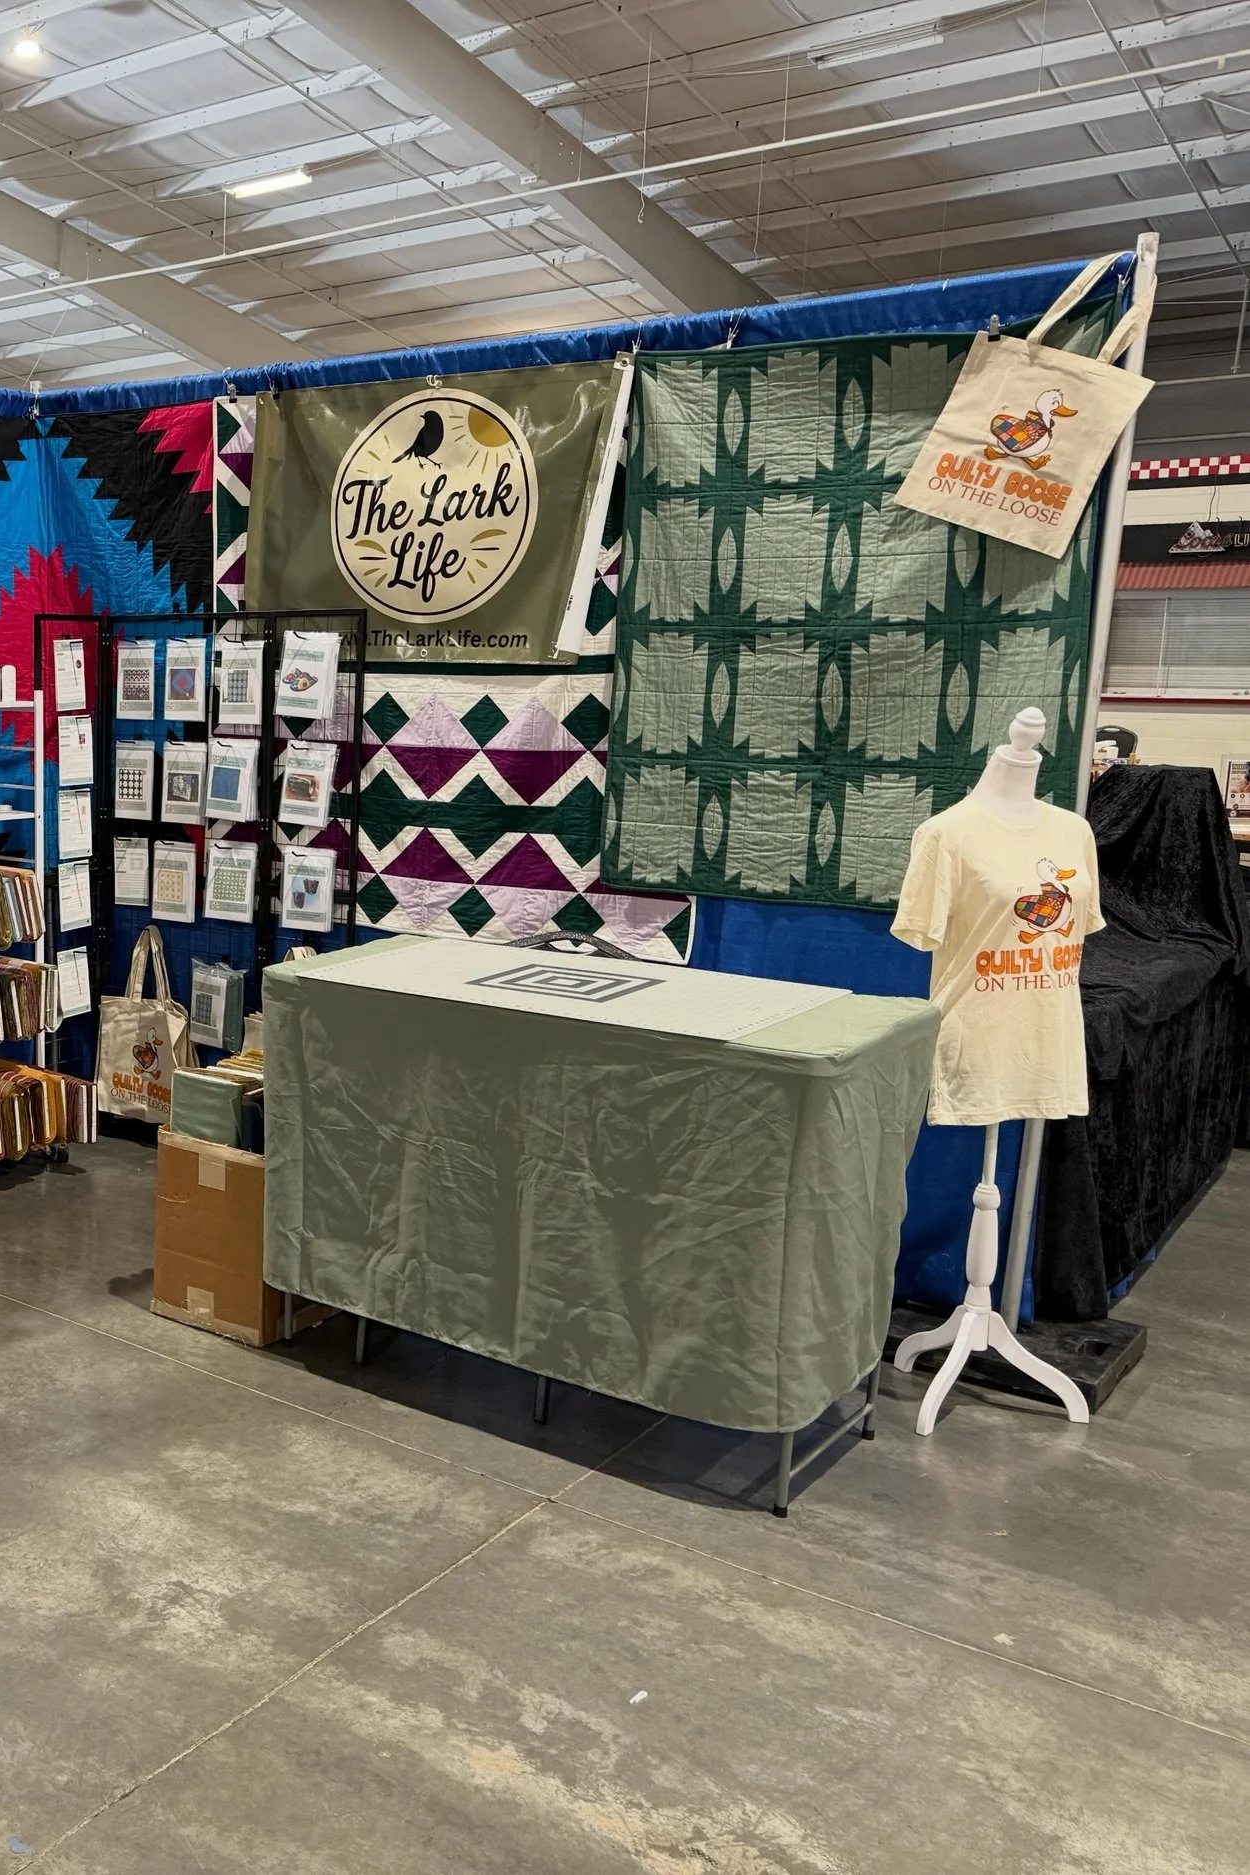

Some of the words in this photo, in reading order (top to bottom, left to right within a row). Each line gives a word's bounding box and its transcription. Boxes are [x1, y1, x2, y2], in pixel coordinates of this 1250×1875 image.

[936, 453, 1001, 488] QUILTY
[1003, 471, 1073, 511] GOOSE
[342, 474, 414, 540] The
[417, 462, 520, 528] Lark
[928, 476, 956, 495] ON
[961, 484, 996, 507] THE
[998, 496, 1062, 526] LOOSE
[387, 531, 467, 603] Life
[338, 629, 528, 648] w.TheLarkLife.com
[976, 948, 1043, 977] QUILTY
[975, 977, 1004, 992] ON
[1012, 974, 1051, 991] THE
[111, 1087, 125, 1098] ON
[128, 1091, 146, 1105] THE
[113, 1071, 144, 1094] QUILTY
